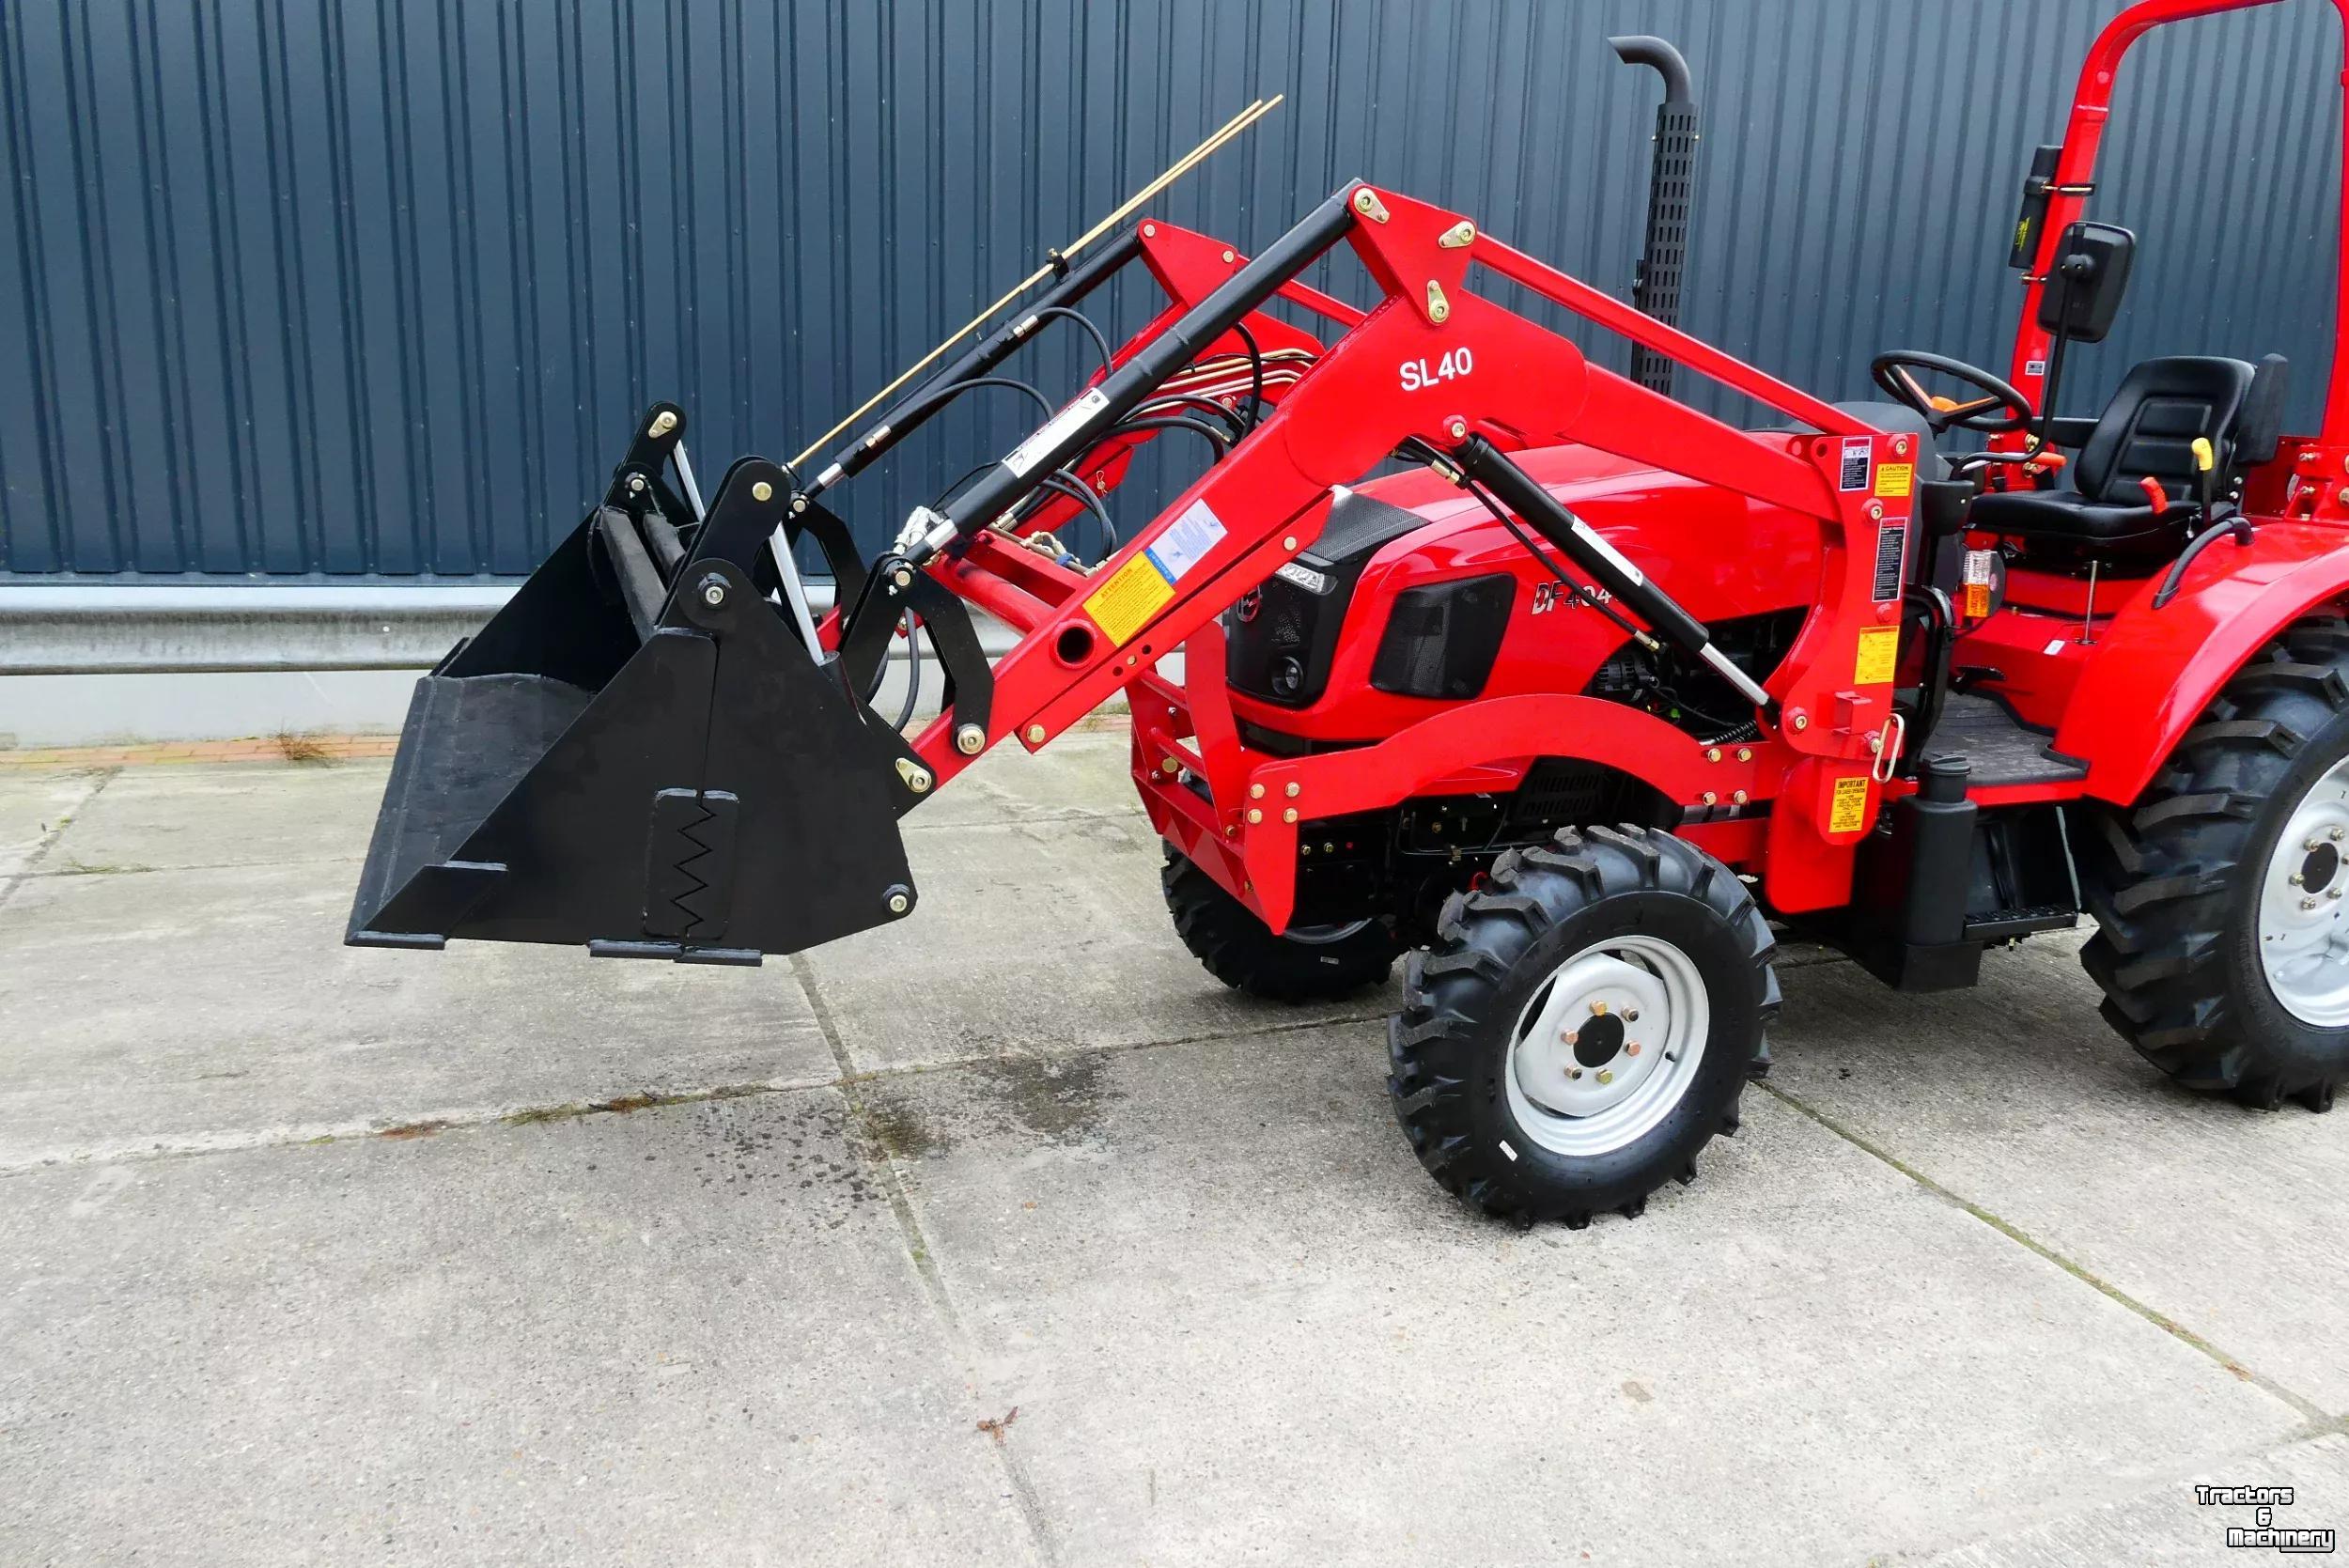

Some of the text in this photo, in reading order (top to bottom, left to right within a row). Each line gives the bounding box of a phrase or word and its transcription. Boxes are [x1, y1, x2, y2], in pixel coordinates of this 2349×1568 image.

[1399, 347, 1472, 391] SL40
[1100, 567, 1133, 598] ATTENTION
[1838, 780, 1866, 788] IMPORTANT
